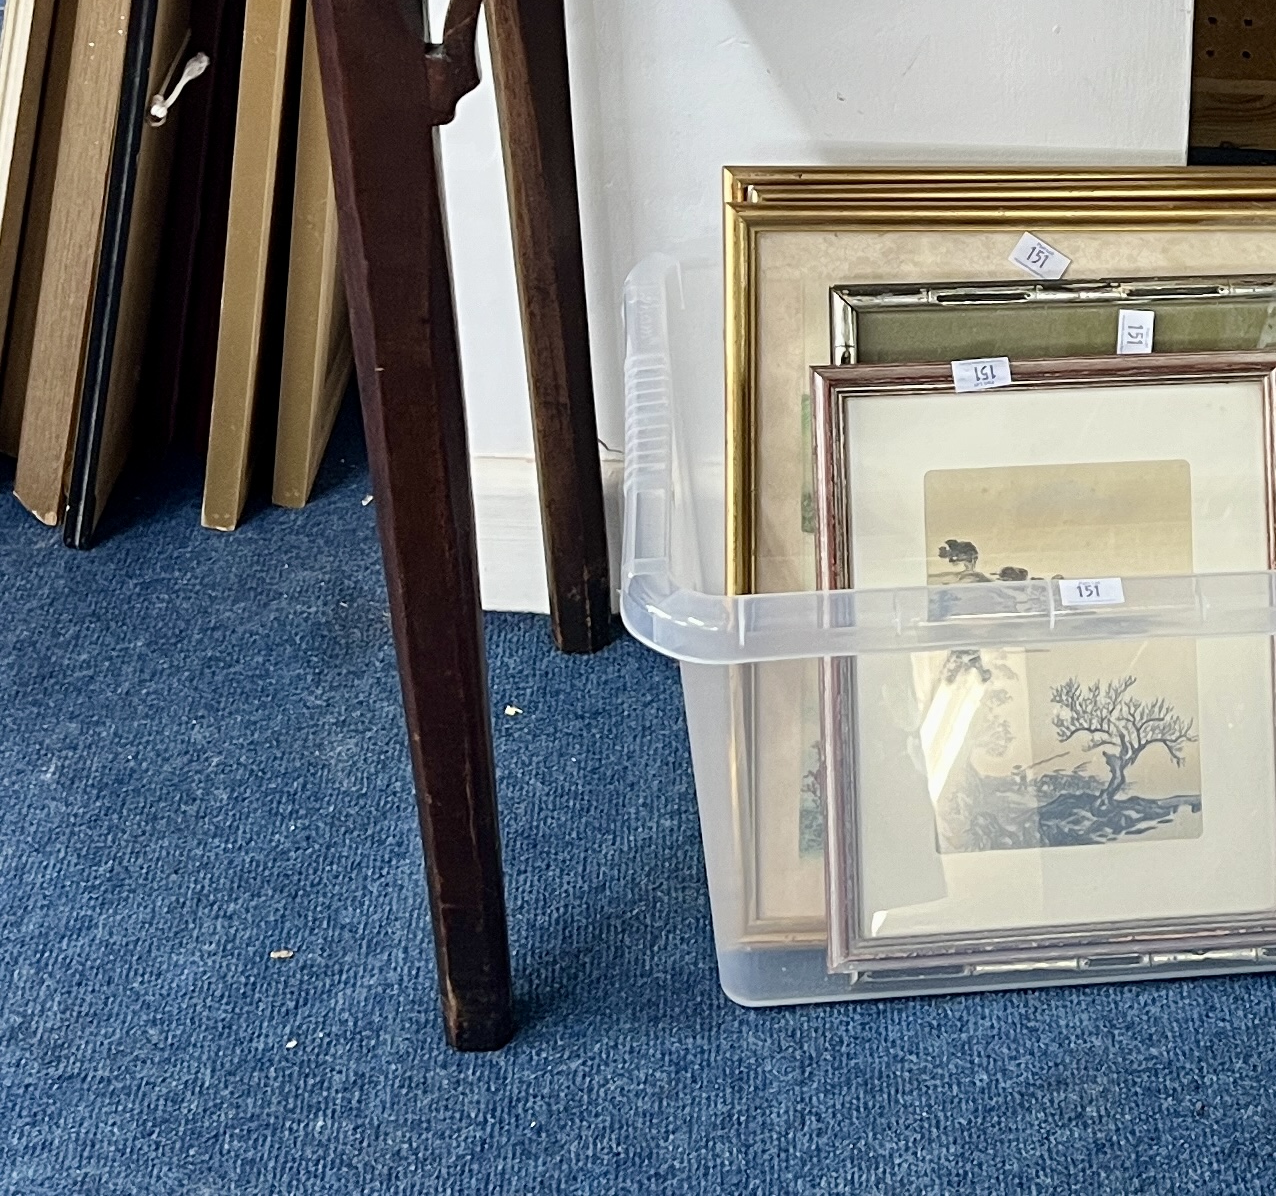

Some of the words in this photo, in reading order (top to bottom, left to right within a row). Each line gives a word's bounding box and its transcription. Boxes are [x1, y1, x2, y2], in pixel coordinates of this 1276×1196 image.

[1026, 245, 1050, 269] 151
[1126, 324, 1144, 345] 151
[973, 364, 997, 382] 151
[1076, 584, 1101, 598] 151
